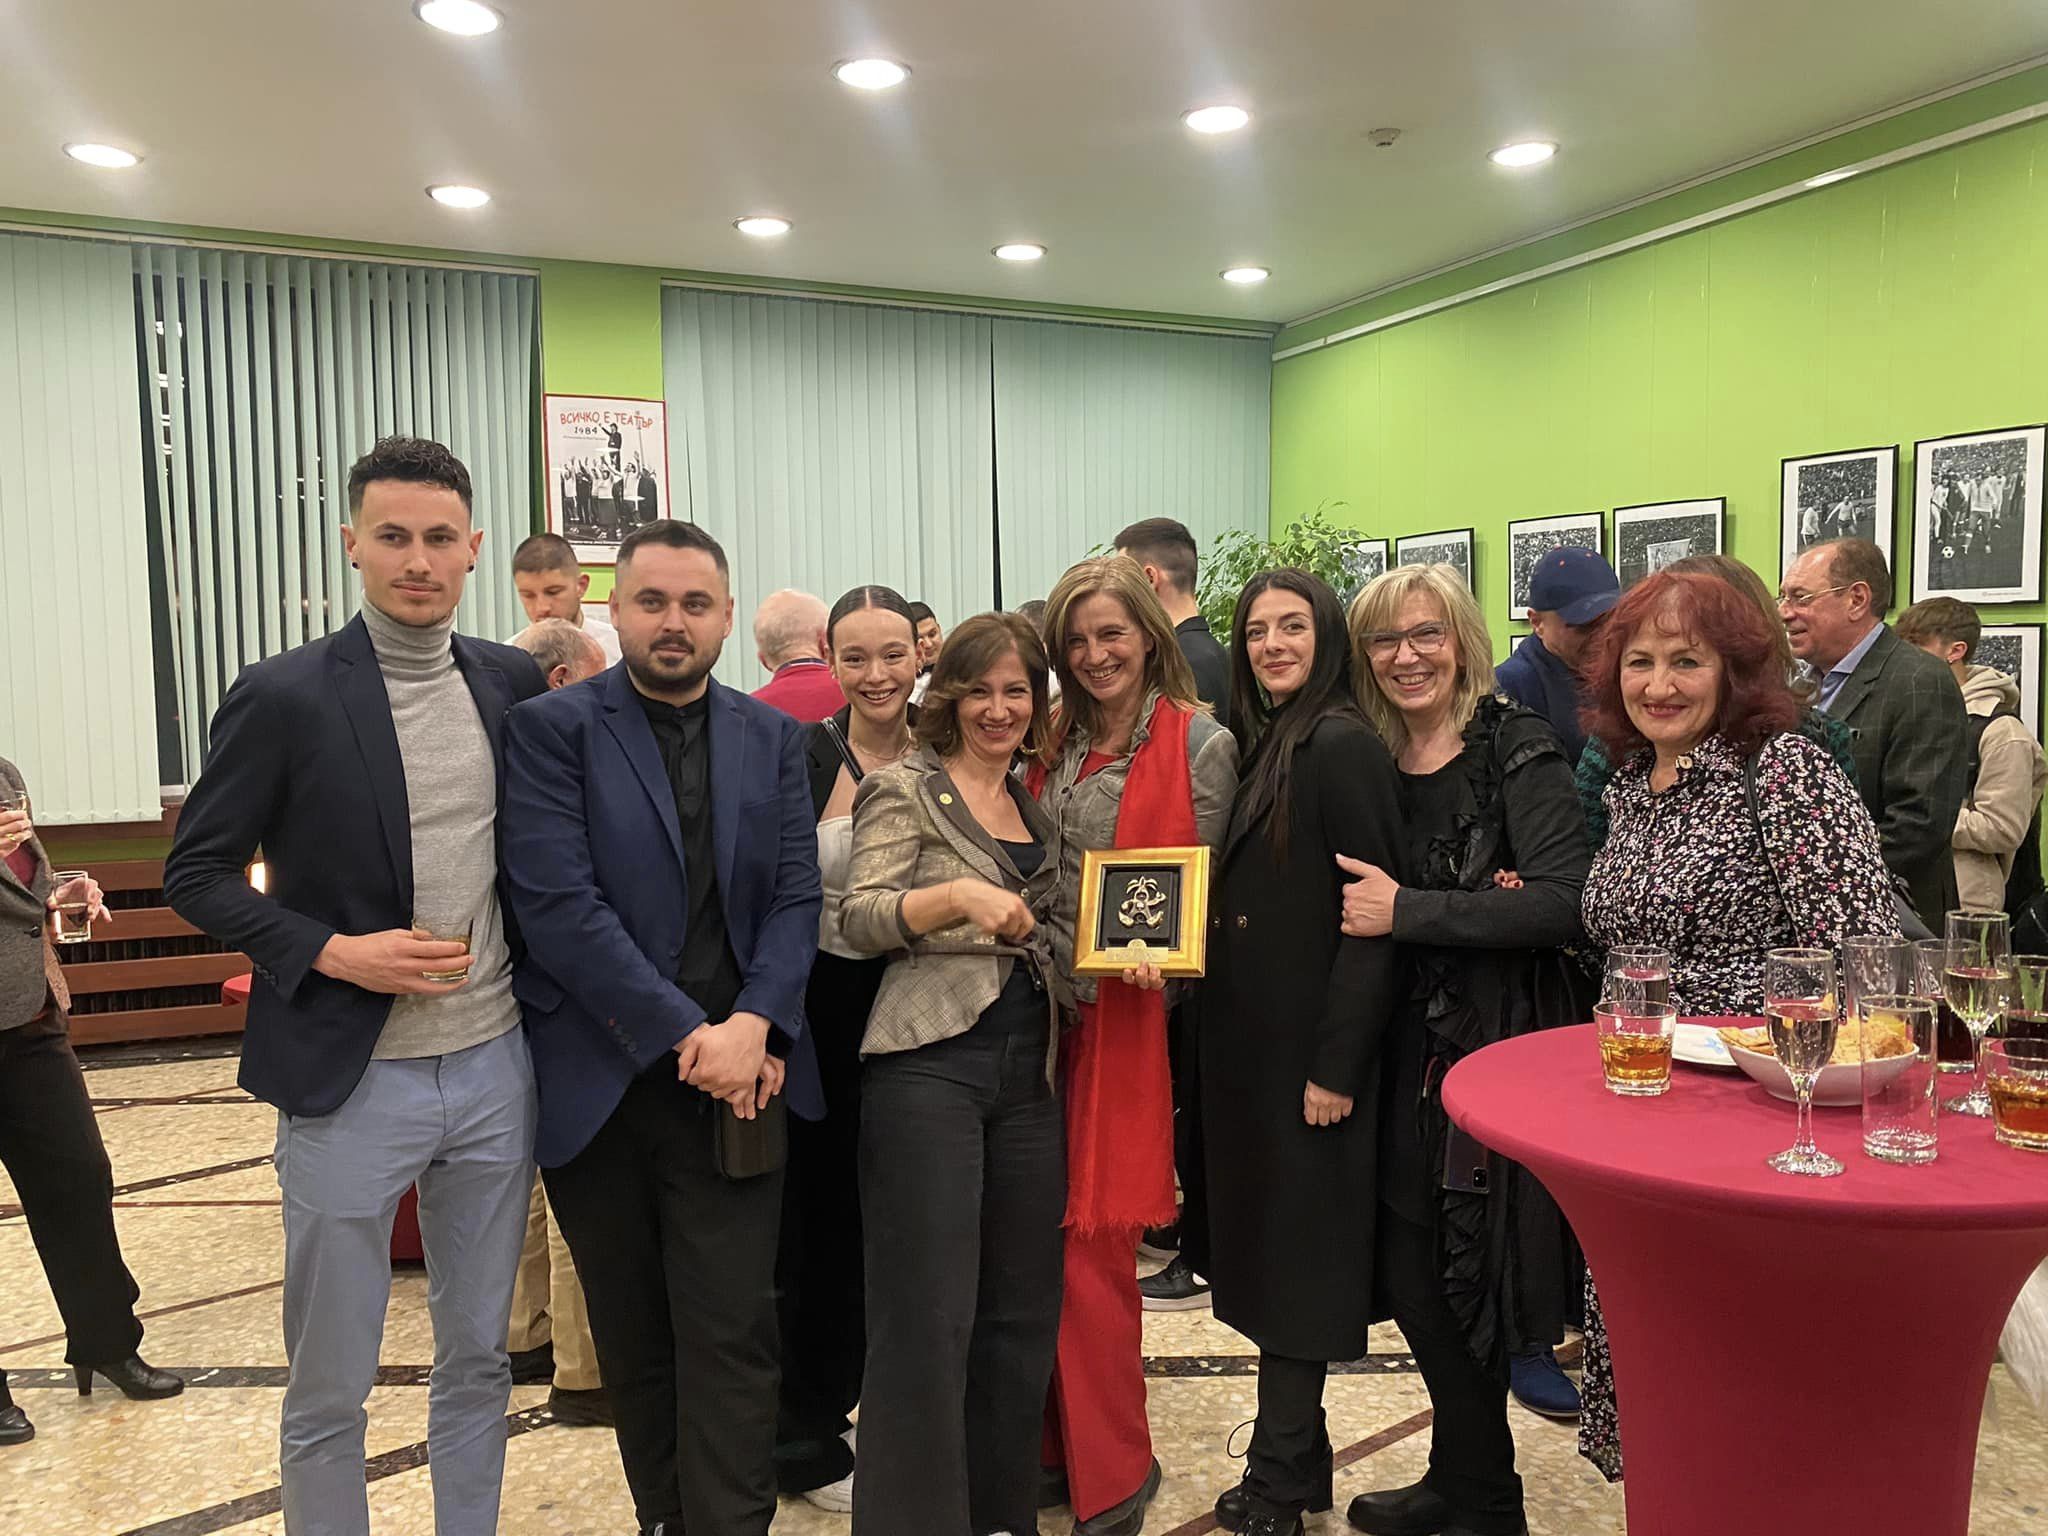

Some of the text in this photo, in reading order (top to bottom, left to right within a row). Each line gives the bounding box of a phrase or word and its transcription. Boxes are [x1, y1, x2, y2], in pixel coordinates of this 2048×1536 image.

[560, 411, 653, 428] ВСИЧКО Е ТЕАТЪР
[574, 426, 598, 435] 1984
